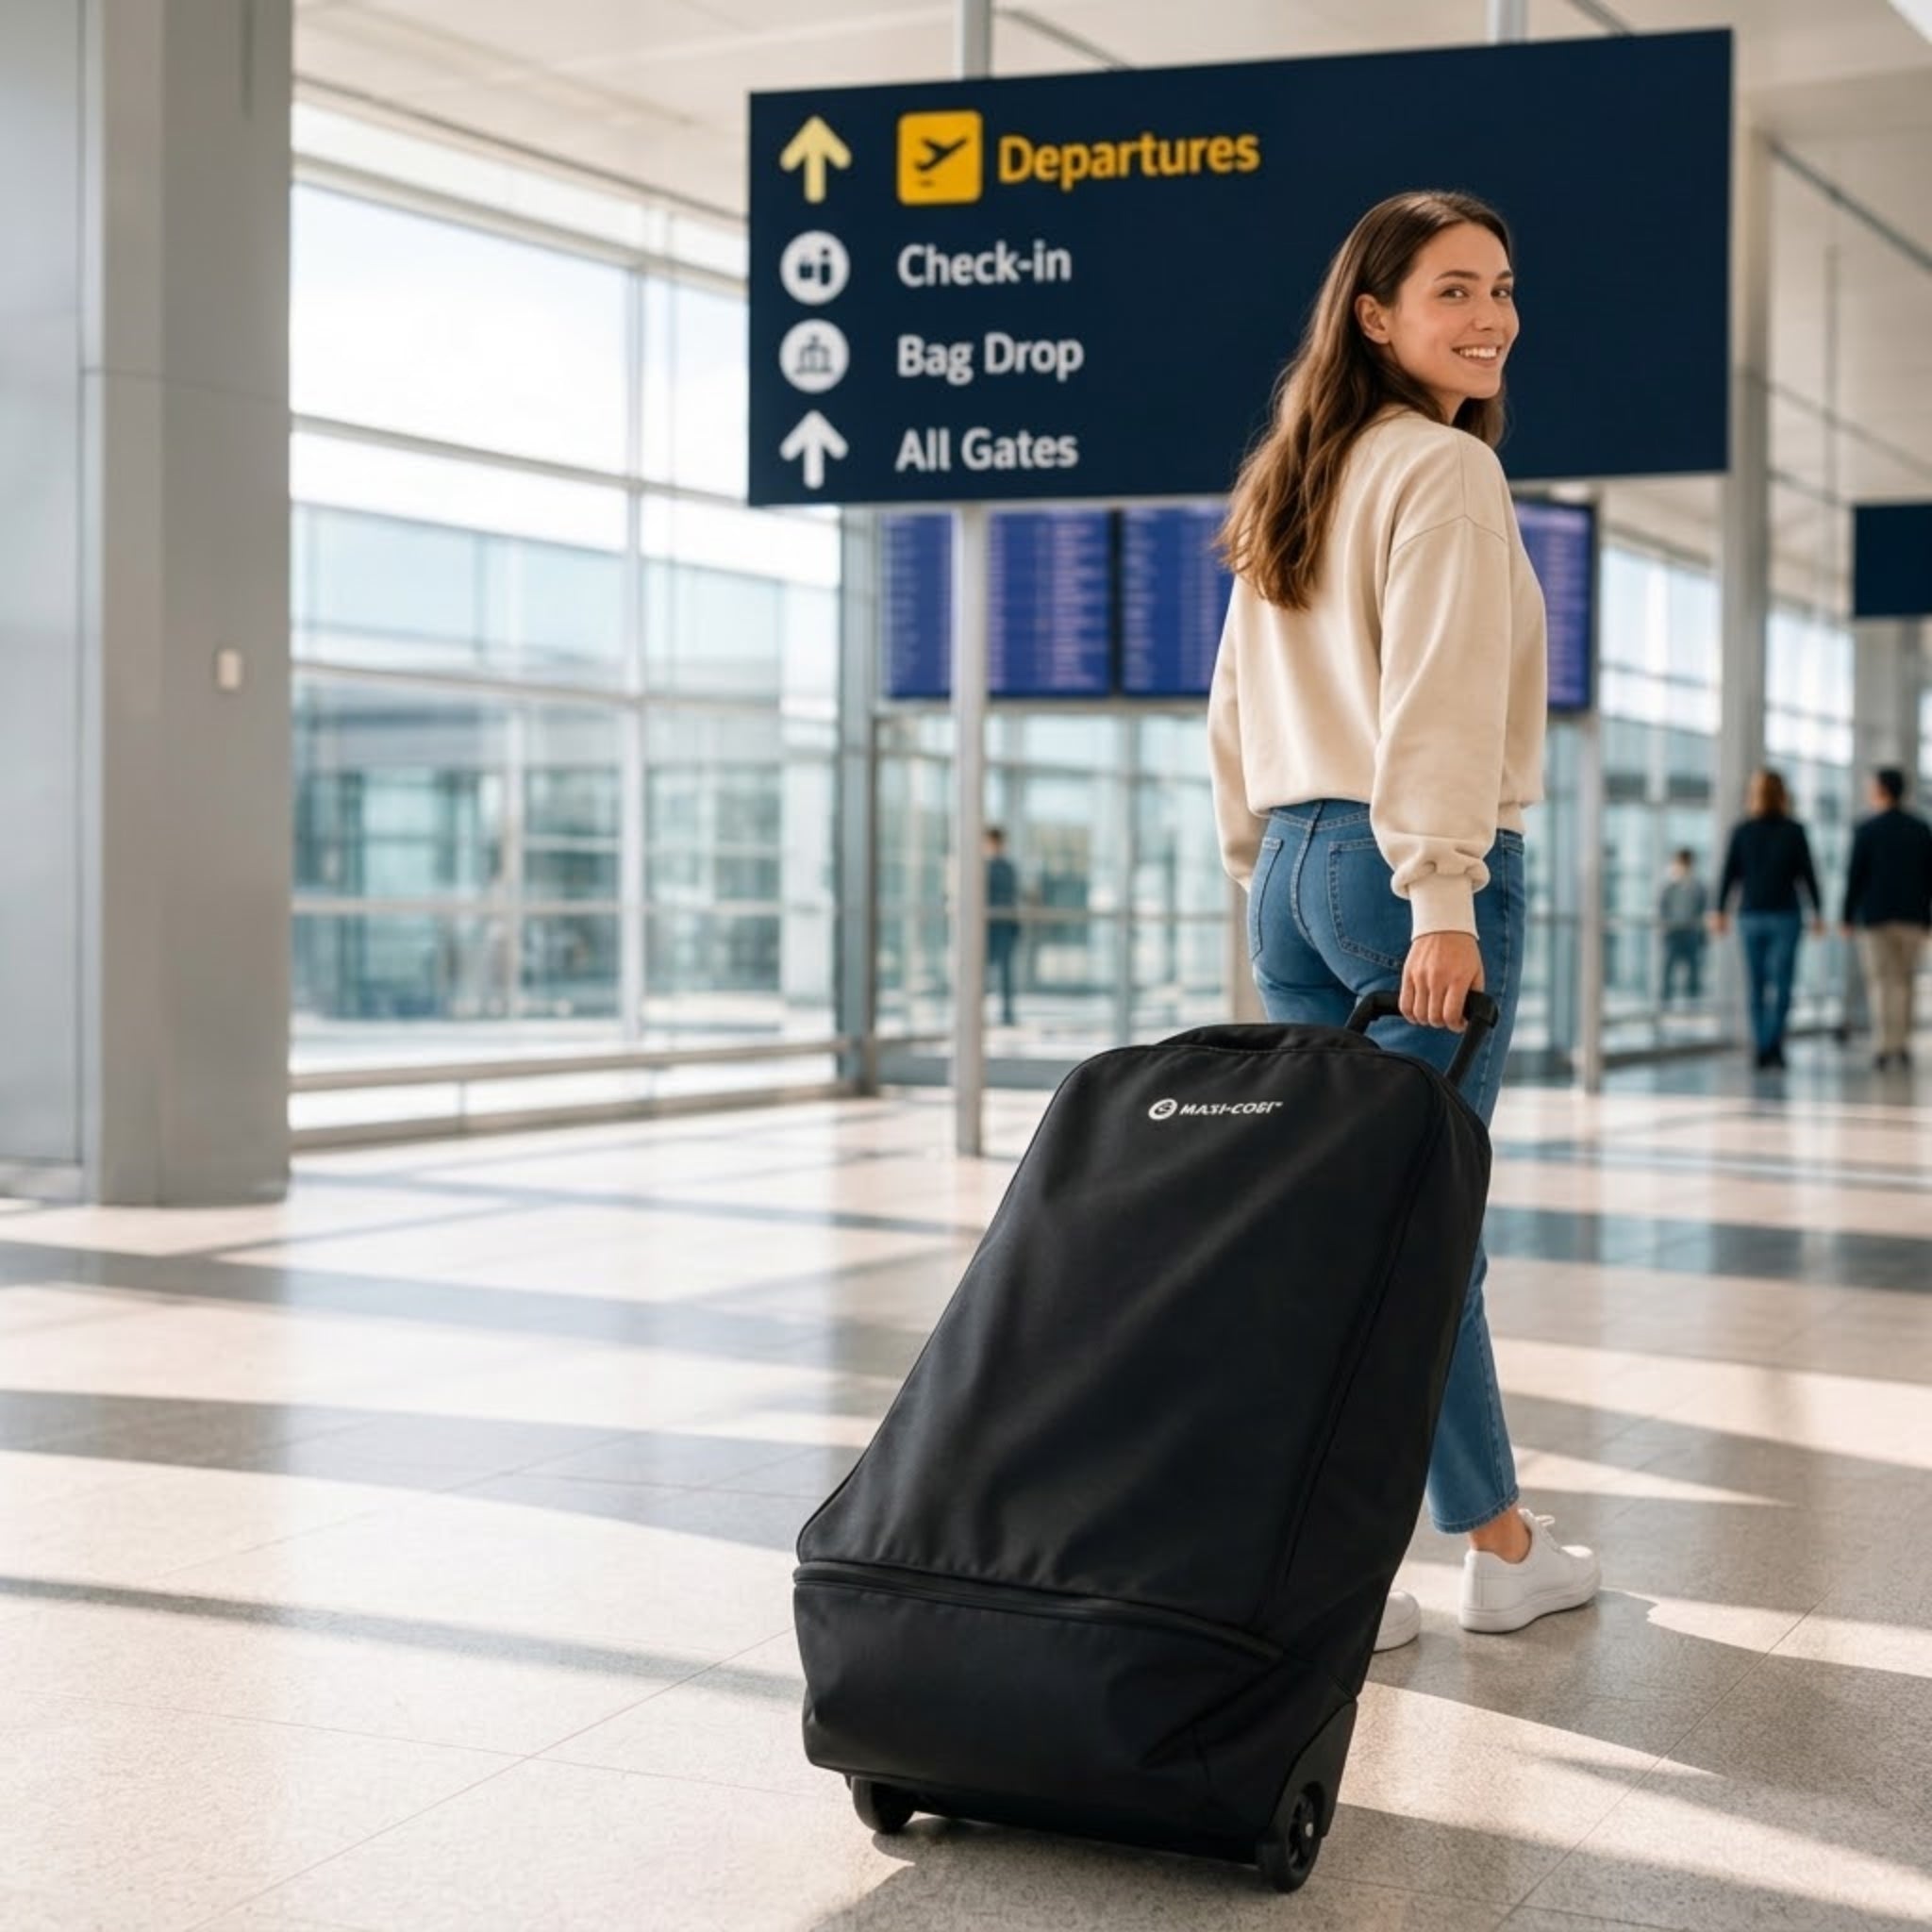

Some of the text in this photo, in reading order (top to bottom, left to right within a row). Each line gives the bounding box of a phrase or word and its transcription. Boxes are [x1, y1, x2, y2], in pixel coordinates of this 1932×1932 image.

[997, 134, 1260, 192] Departures
[897, 241, 1073, 287] Check-in
[897, 332, 1084, 386] Bag Drop
[895, 427, 1079, 472] All Gates
